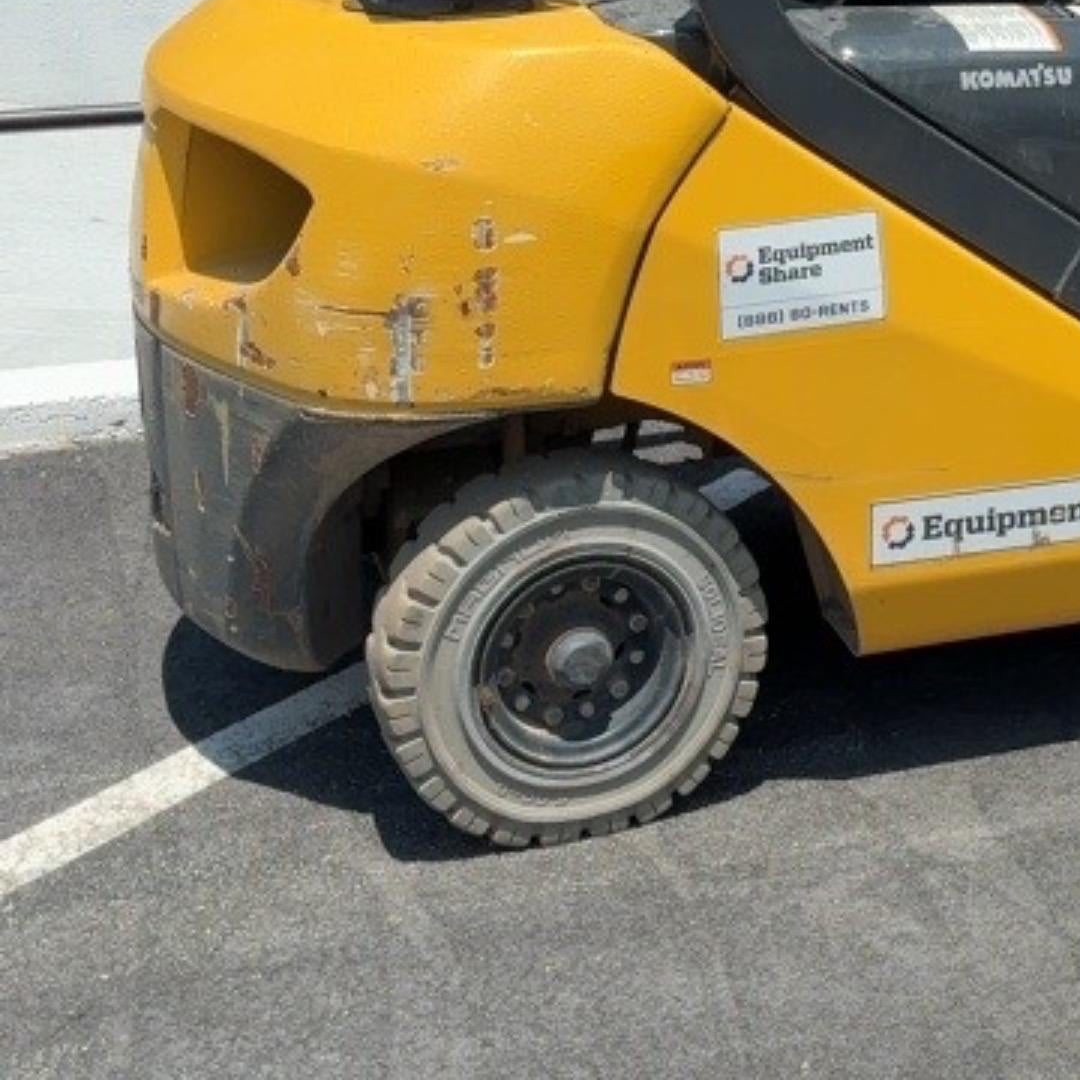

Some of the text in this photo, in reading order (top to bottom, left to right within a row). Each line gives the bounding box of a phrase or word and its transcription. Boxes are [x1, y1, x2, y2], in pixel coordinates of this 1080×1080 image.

[959, 63, 1072, 90] KOMATSU
[758, 233, 874, 264] Equipment
[758, 263, 822, 285] Share
